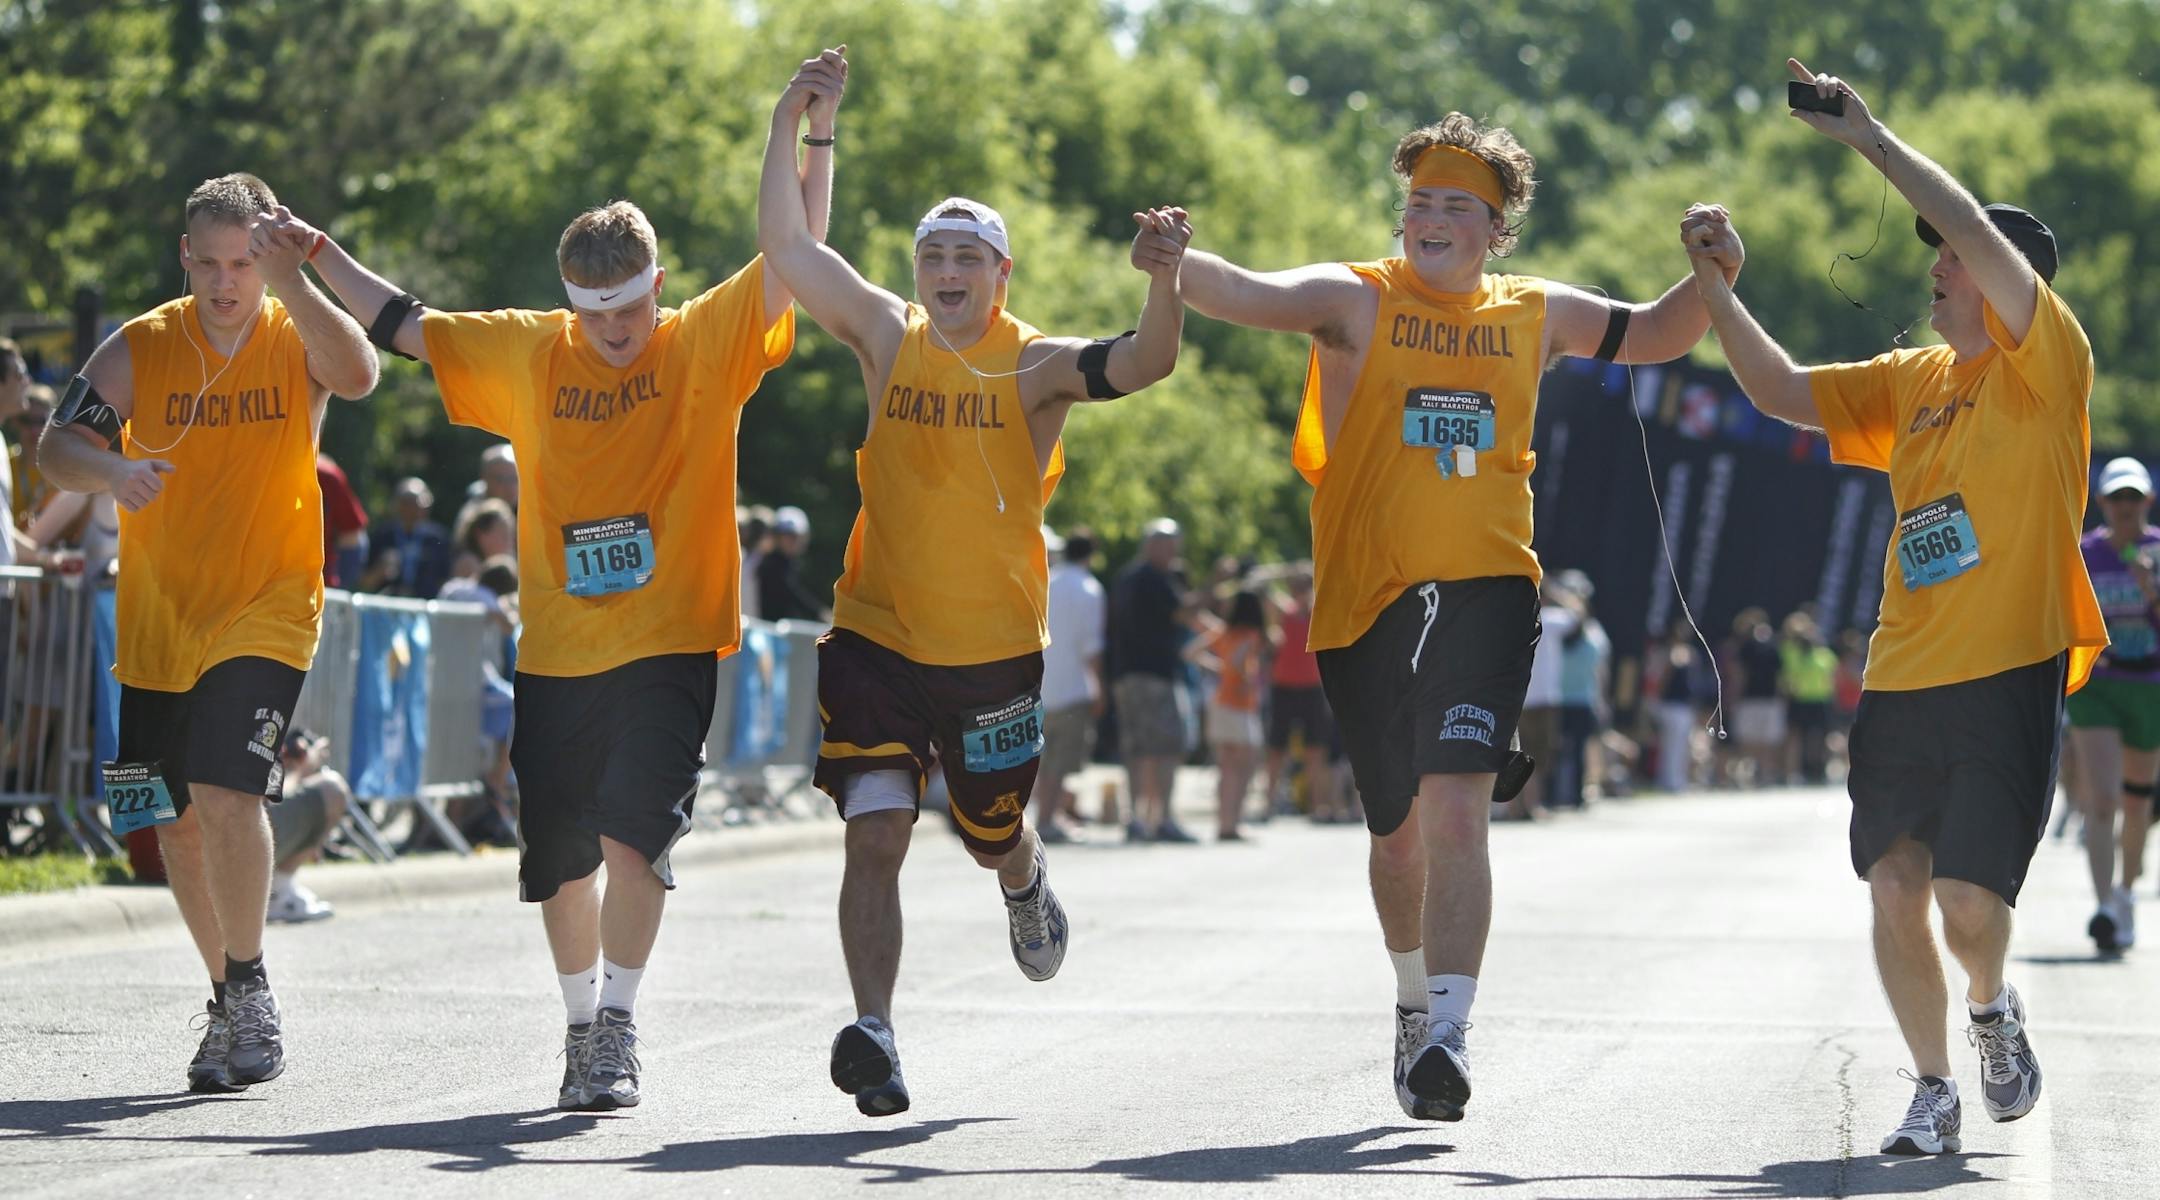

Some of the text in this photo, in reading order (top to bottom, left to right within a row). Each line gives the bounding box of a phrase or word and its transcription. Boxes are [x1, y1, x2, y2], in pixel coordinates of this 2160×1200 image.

[1391, 313, 1513, 358] COACH KILL
[165, 386, 286, 427] COACH KILL
[887, 385, 1005, 428] COACH KILL
[1420, 394, 1480, 405] MINNEAPOLIS
[1422, 401, 1479, 411] HALF MARATHON
[1418, 415, 1480, 447] 1635
[573, 521, 635, 536] MINNEAPOLIS
[575, 533, 592, 542] HALF
[595, 528, 634, 539] MARATHON
[577, 541, 642, 576] 1169
[1902, 525, 1962, 569] 1566
[976, 697, 1033, 722] MINNEAPOLIS
[978, 716, 996, 727] HALF
[979, 715, 1039, 754] 1636
